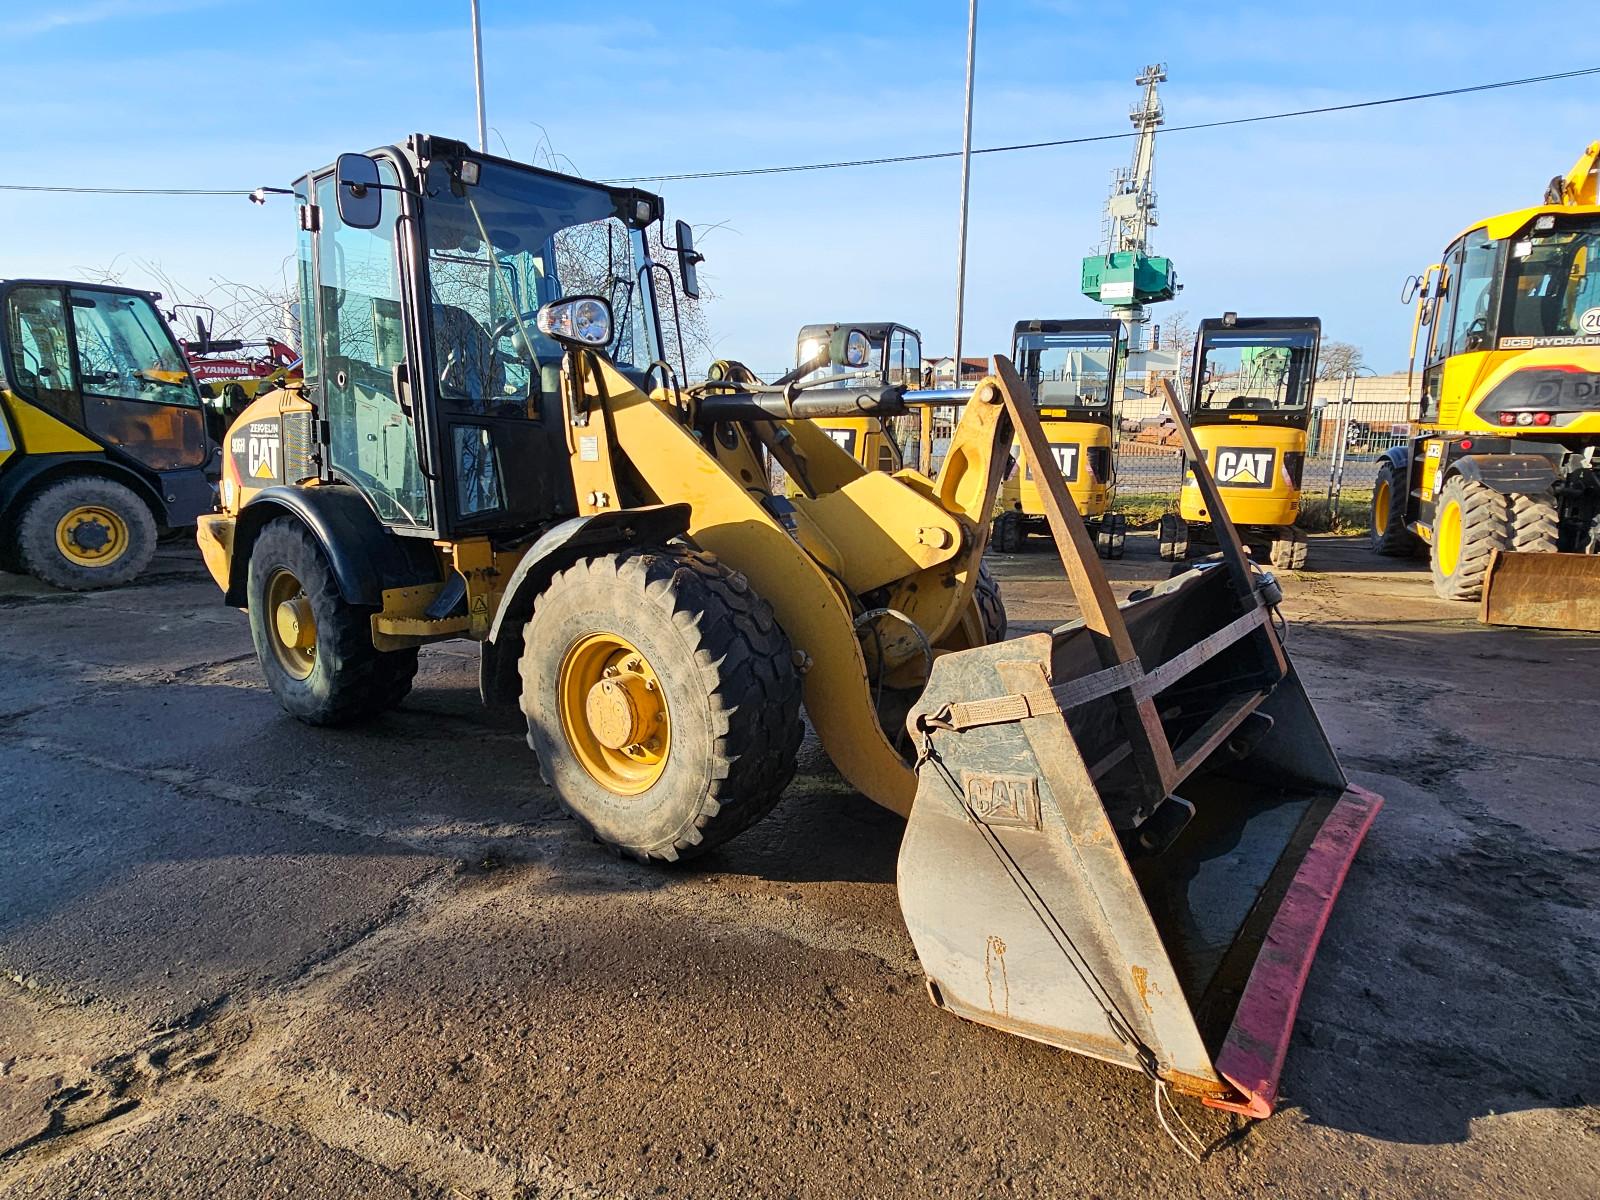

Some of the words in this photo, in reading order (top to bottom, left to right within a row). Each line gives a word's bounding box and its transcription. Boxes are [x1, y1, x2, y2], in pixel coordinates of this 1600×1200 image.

[1503, 339, 1531, 347] JCB
[203, 366, 249, 374] YANMAR
[250, 424, 279, 434] ZEPPELIN
[248, 438, 280, 479] CAT
[1217, 452, 1272, 484] CAT
[968, 779, 1029, 822] CAT
